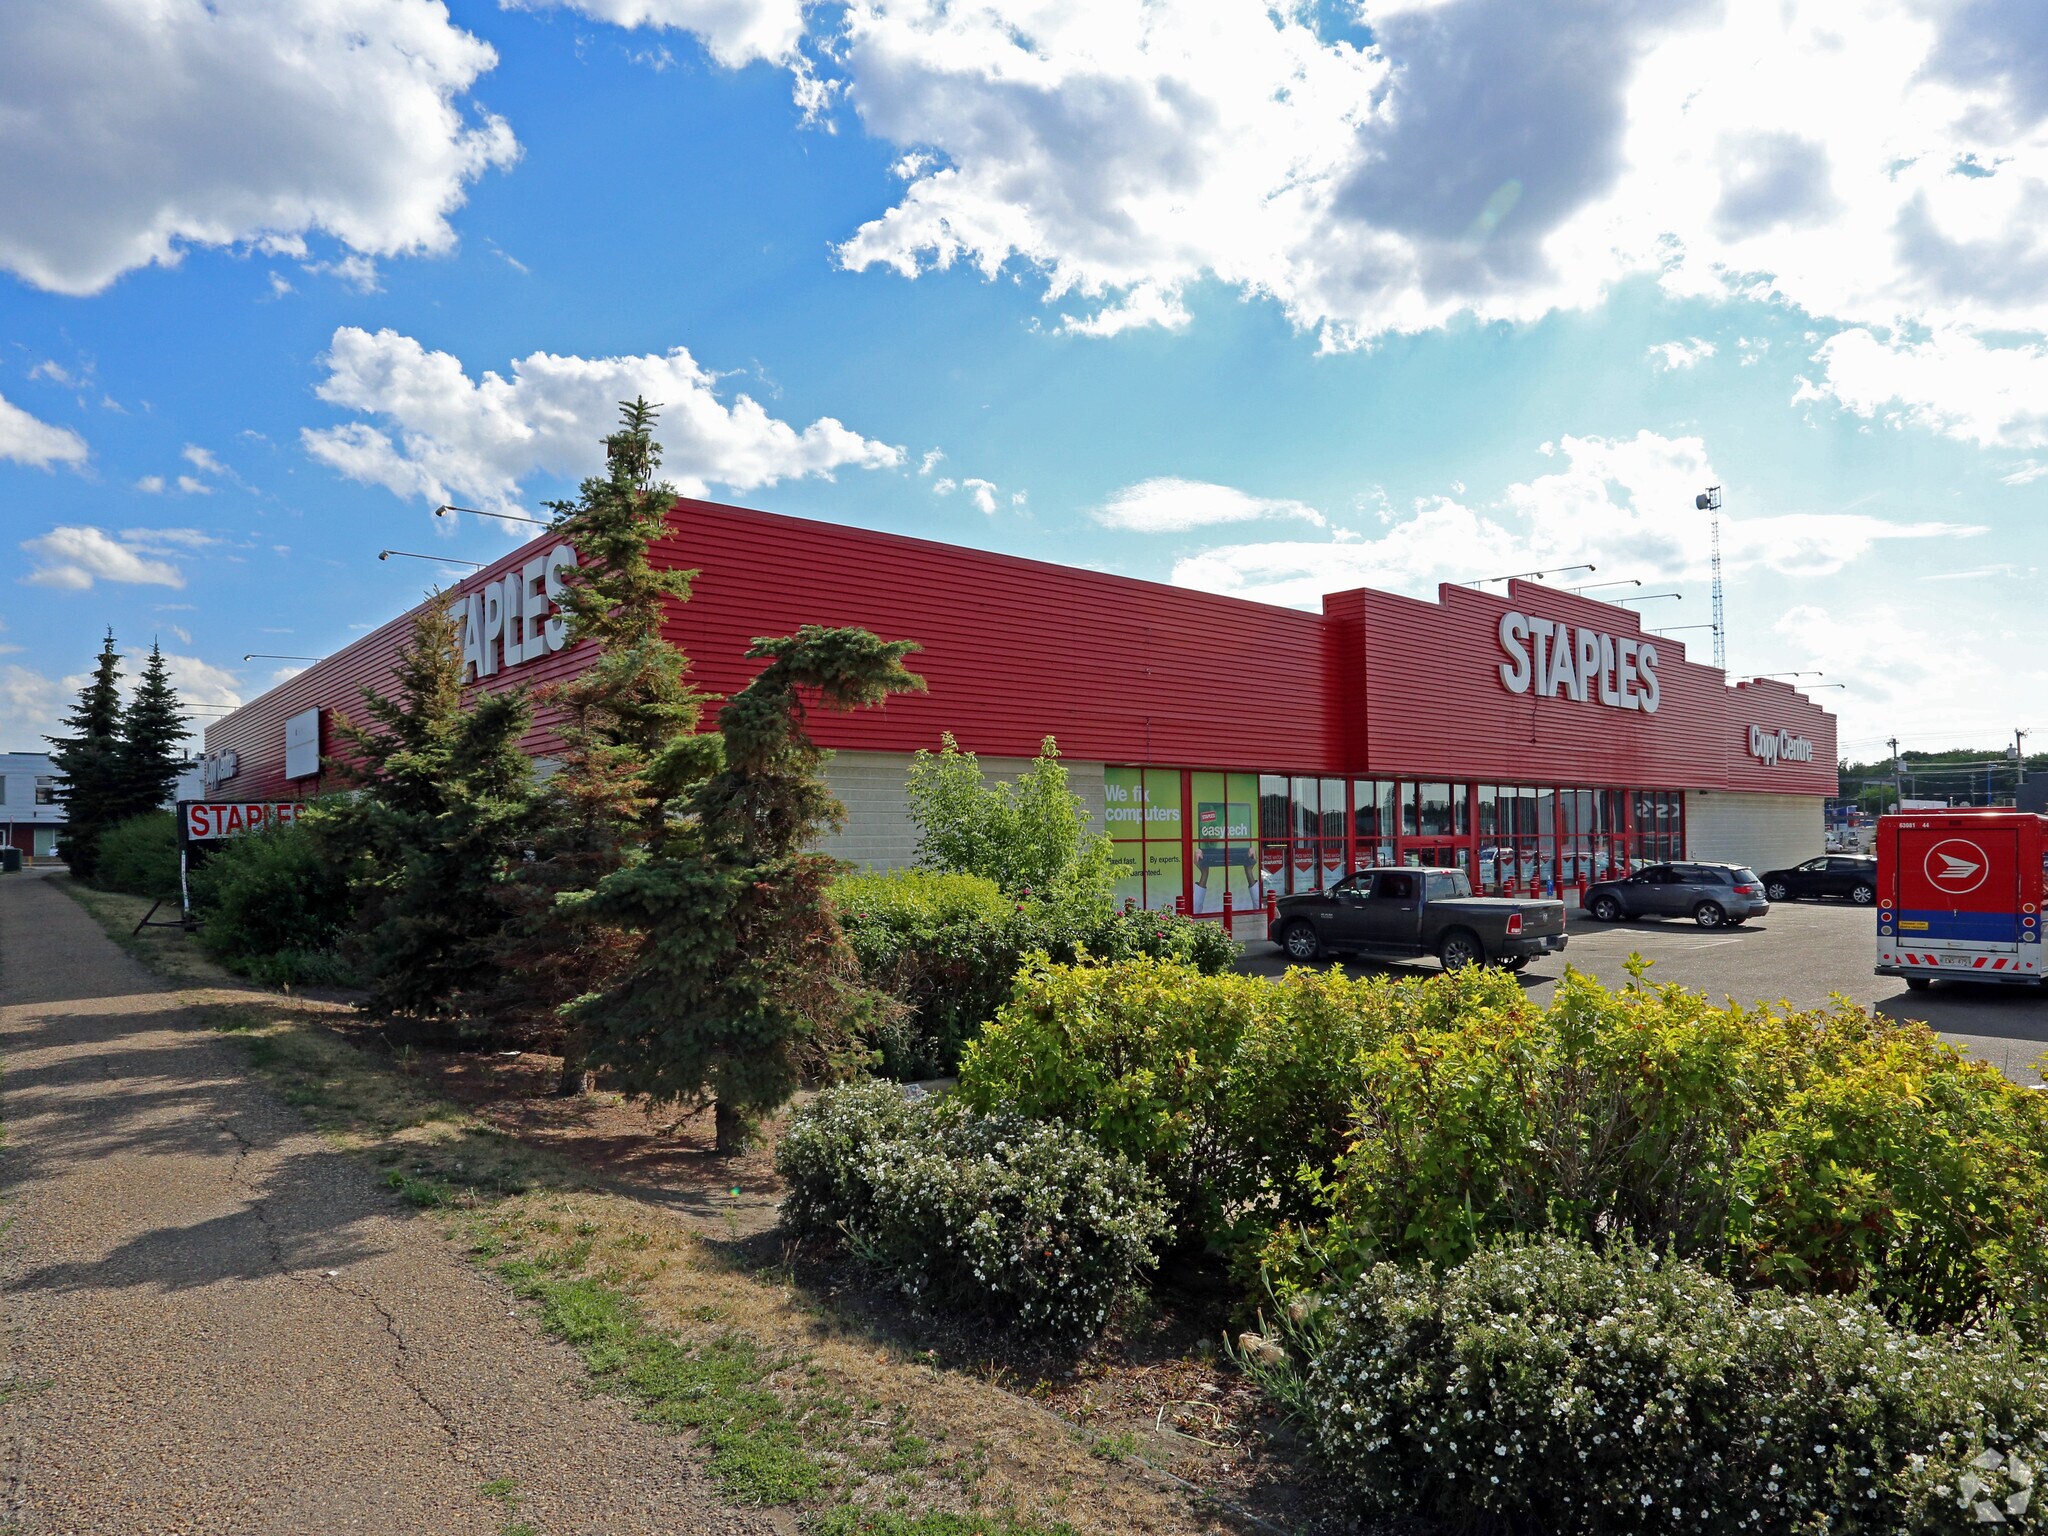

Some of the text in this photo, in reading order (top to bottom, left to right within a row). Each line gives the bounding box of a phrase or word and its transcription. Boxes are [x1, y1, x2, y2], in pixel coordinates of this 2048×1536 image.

[445, 544, 578, 684] TAPLES
[1498, 611, 1660, 714] STAPLES
[1749, 724, 1813, 766] Copy Centre
[1105, 784, 1150, 802] We fix
[1105, 805, 1180, 824] computers
[1150, 855, 1181, 864] By experts.
